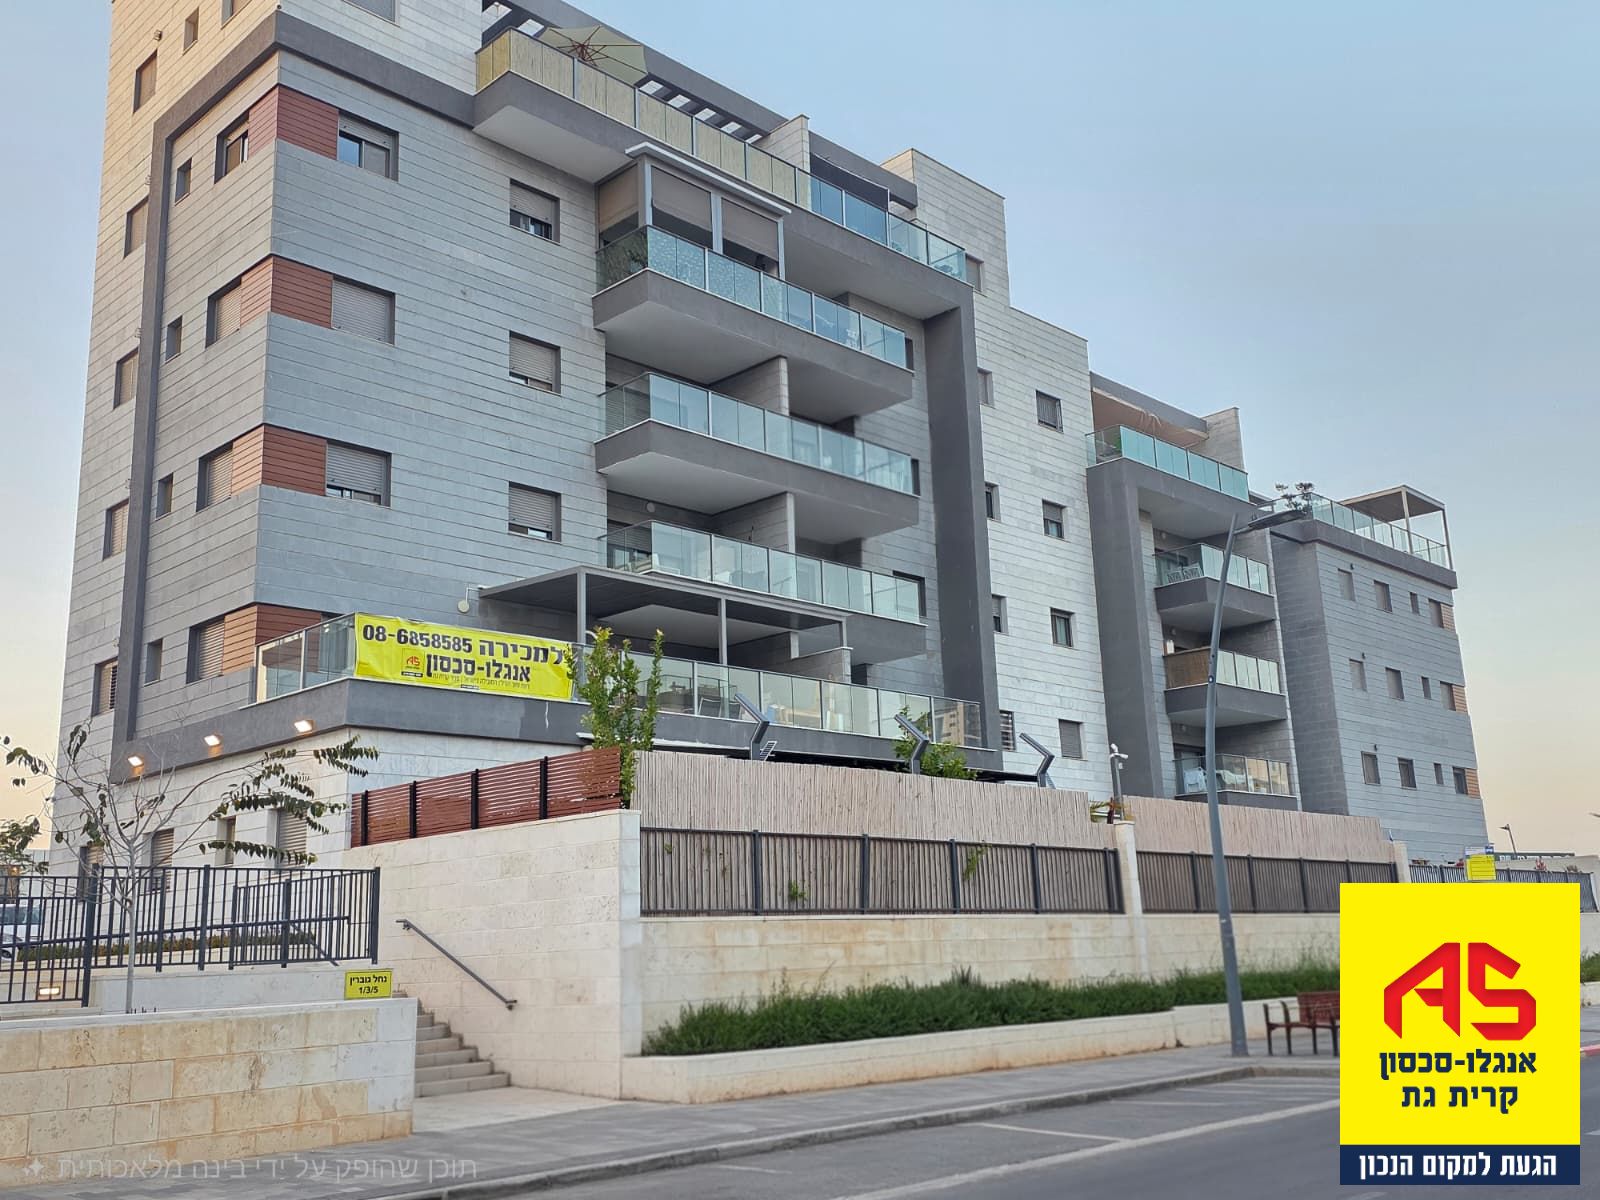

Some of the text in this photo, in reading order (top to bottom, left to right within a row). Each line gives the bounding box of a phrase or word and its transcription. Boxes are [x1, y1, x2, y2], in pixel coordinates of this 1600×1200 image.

[362, 624, 564, 665] למכירה 08-6858585
[426, 653, 531, 683] אנגלו-סכסון
[372, 974, 388, 983] נחל
[358, 985, 379, 994] 1/3/5
